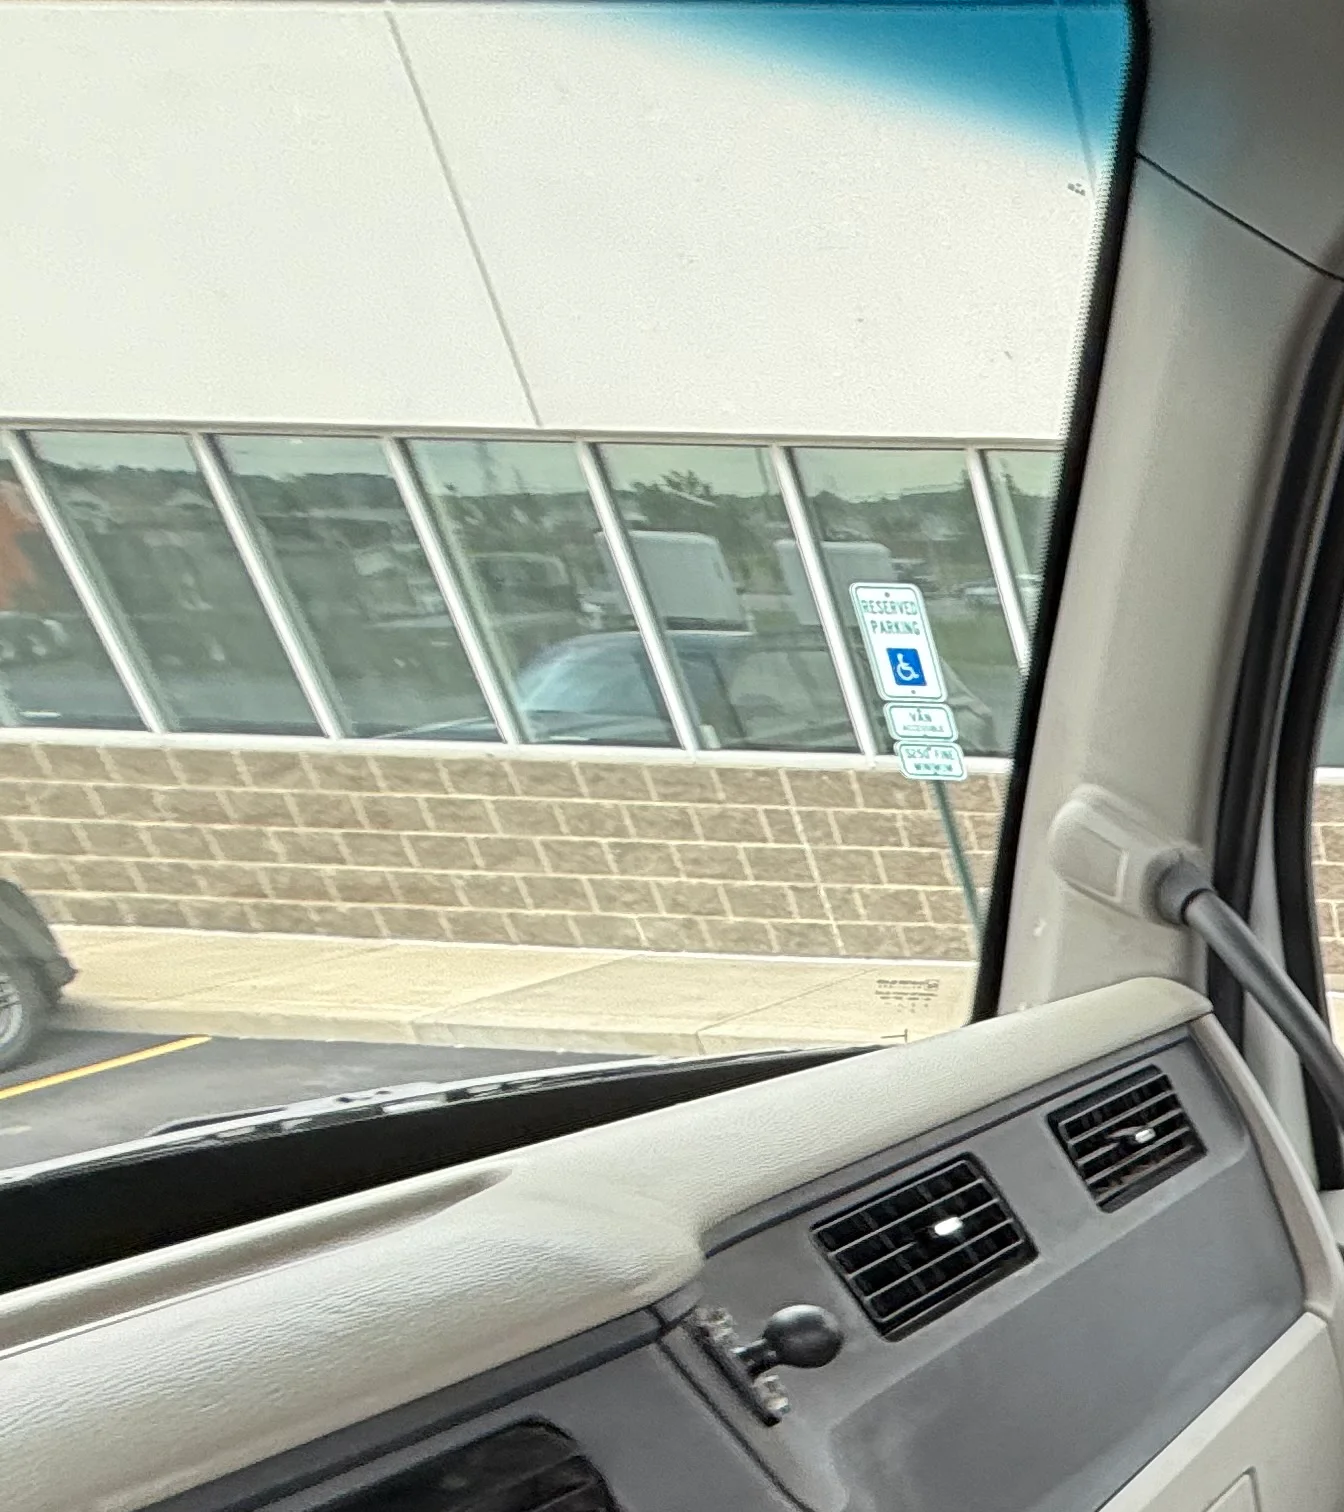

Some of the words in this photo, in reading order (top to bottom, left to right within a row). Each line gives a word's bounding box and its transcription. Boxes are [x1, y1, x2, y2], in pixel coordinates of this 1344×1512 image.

[860, 599, 918, 616] RESERVED
[870, 620, 921, 636] PARKING
[908, 712, 933, 723] VAN
[934, 749, 956, 761] FINE
